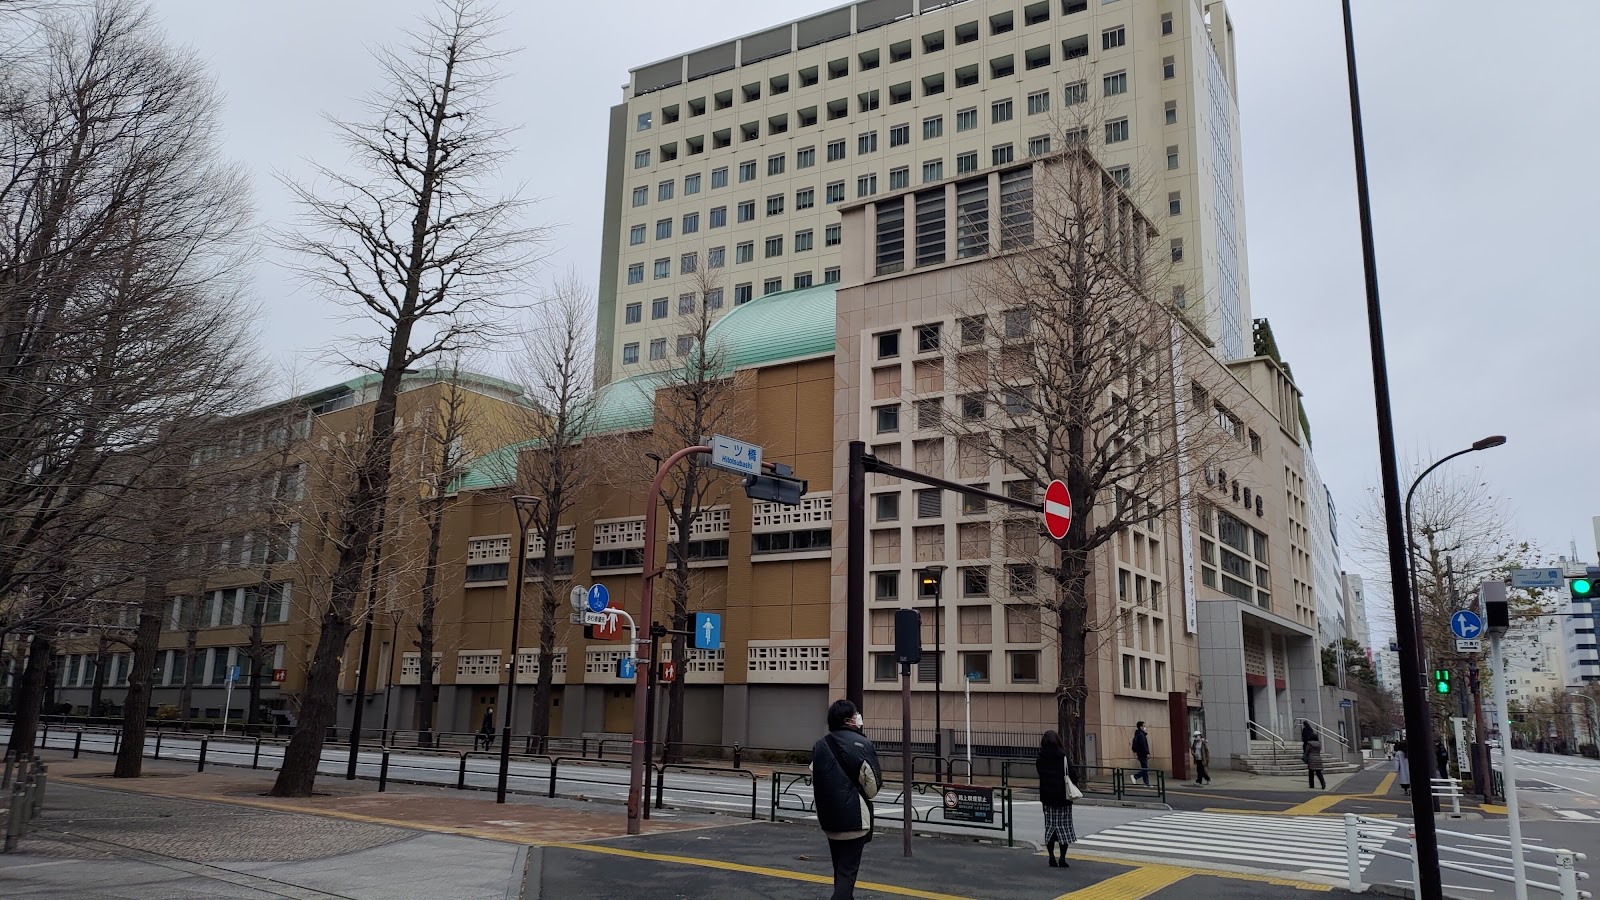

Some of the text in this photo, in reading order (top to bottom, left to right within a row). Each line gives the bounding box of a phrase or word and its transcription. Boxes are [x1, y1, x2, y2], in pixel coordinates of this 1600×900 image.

[720, 445, 756, 461] 一ツ橋
[722, 455, 753, 469] Hitotsubashi
[1516, 570, 1558, 579] 一ツ橋
